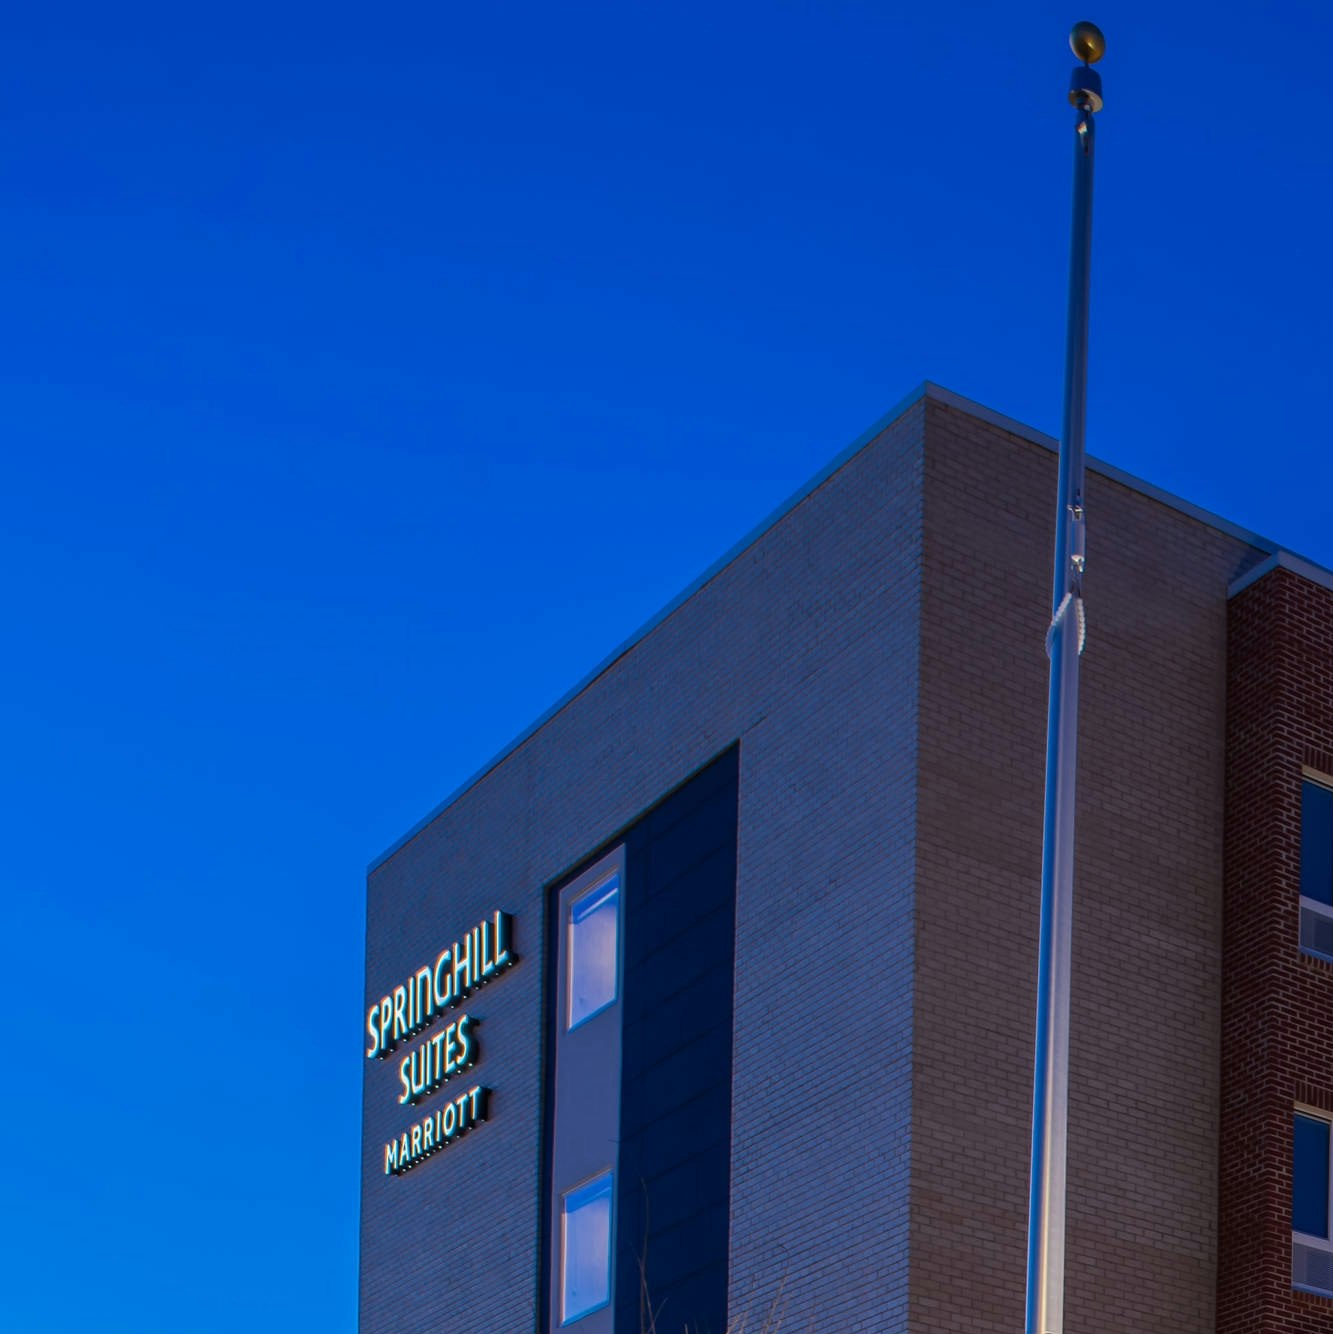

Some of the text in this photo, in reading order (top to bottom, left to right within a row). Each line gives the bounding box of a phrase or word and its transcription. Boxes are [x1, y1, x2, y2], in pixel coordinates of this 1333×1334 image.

[366, 909, 508, 1059] SPRINGHILL
[398, 1013, 471, 1105] SUITES
[384, 1084, 483, 1176] MARRIOTT
